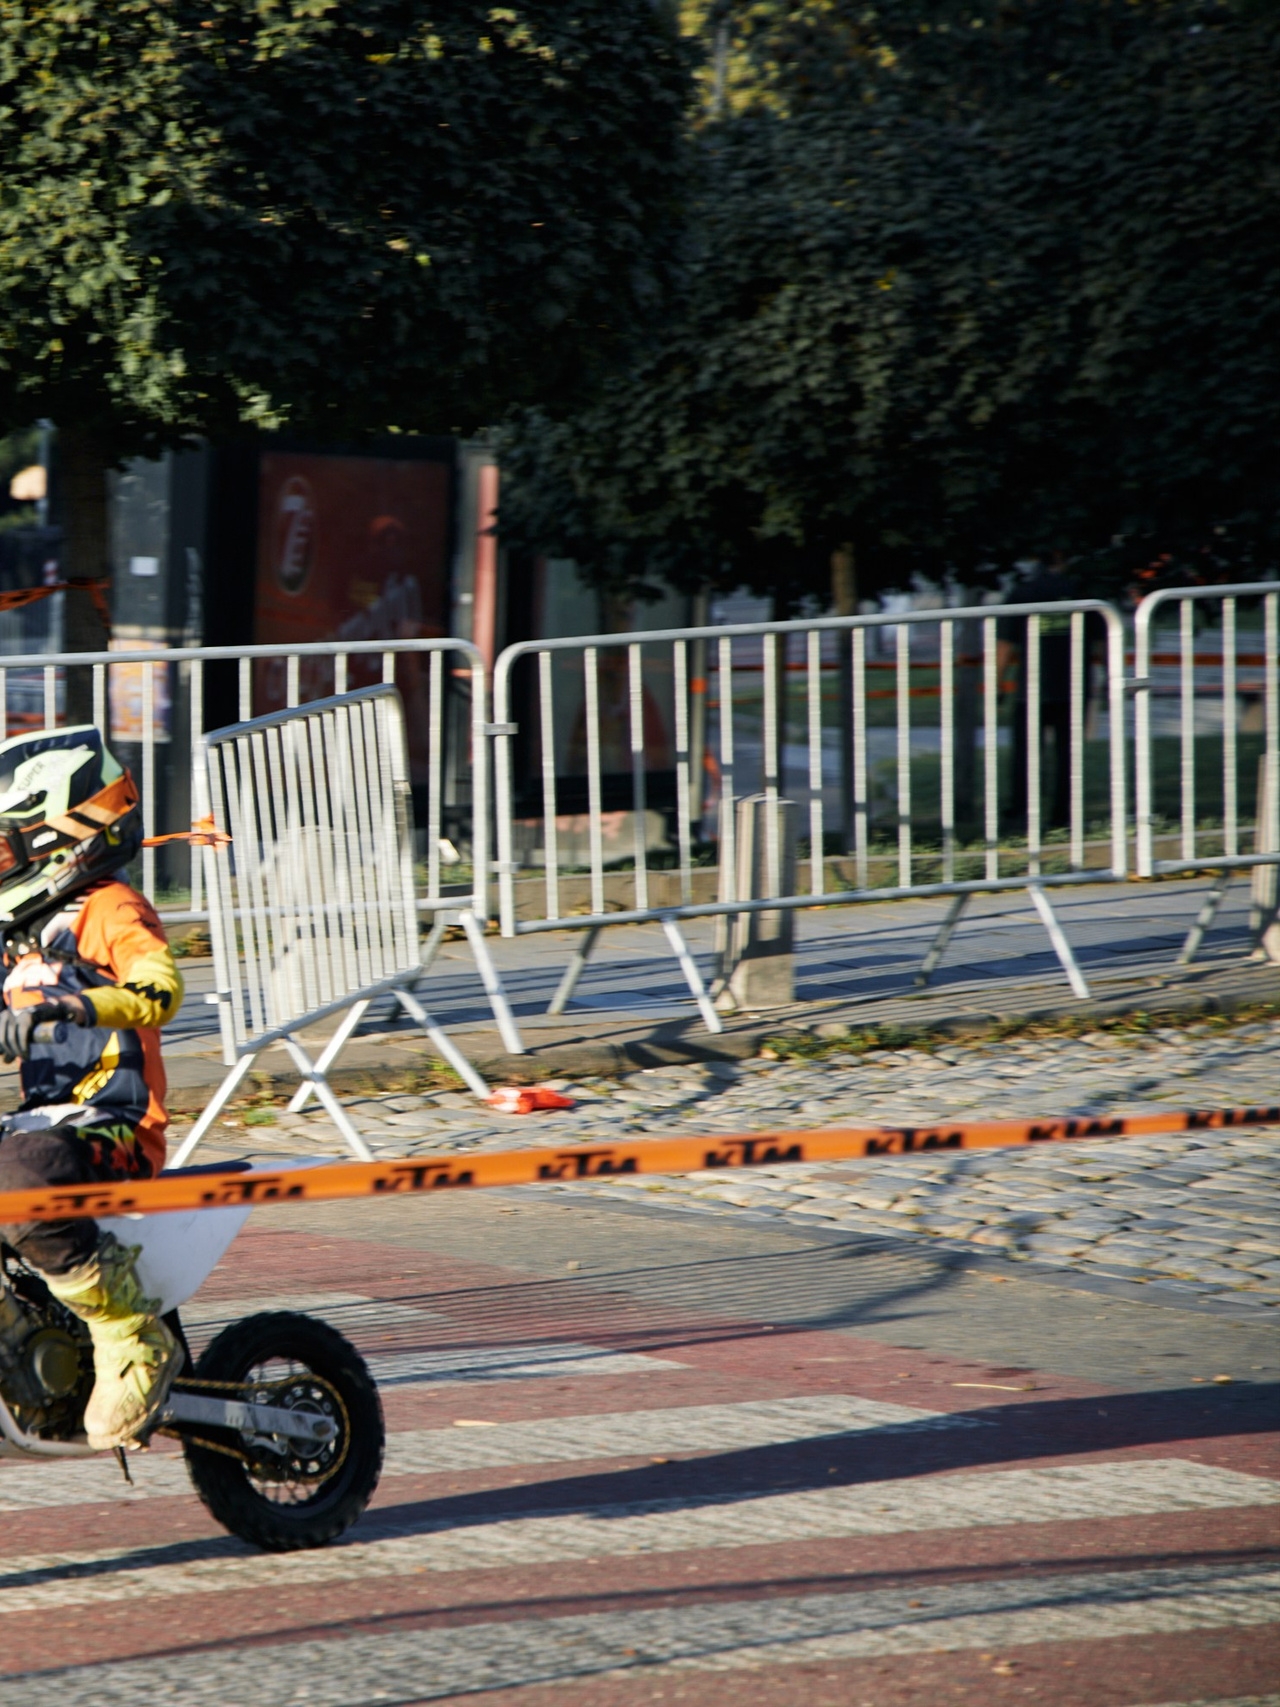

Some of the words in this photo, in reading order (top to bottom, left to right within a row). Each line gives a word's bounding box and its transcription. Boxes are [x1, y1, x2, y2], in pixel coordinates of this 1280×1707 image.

[538, 1150, 639, 1179] KTM
[704, 1136, 804, 1168] KTM
[864, 1126, 964, 1156] KTM
